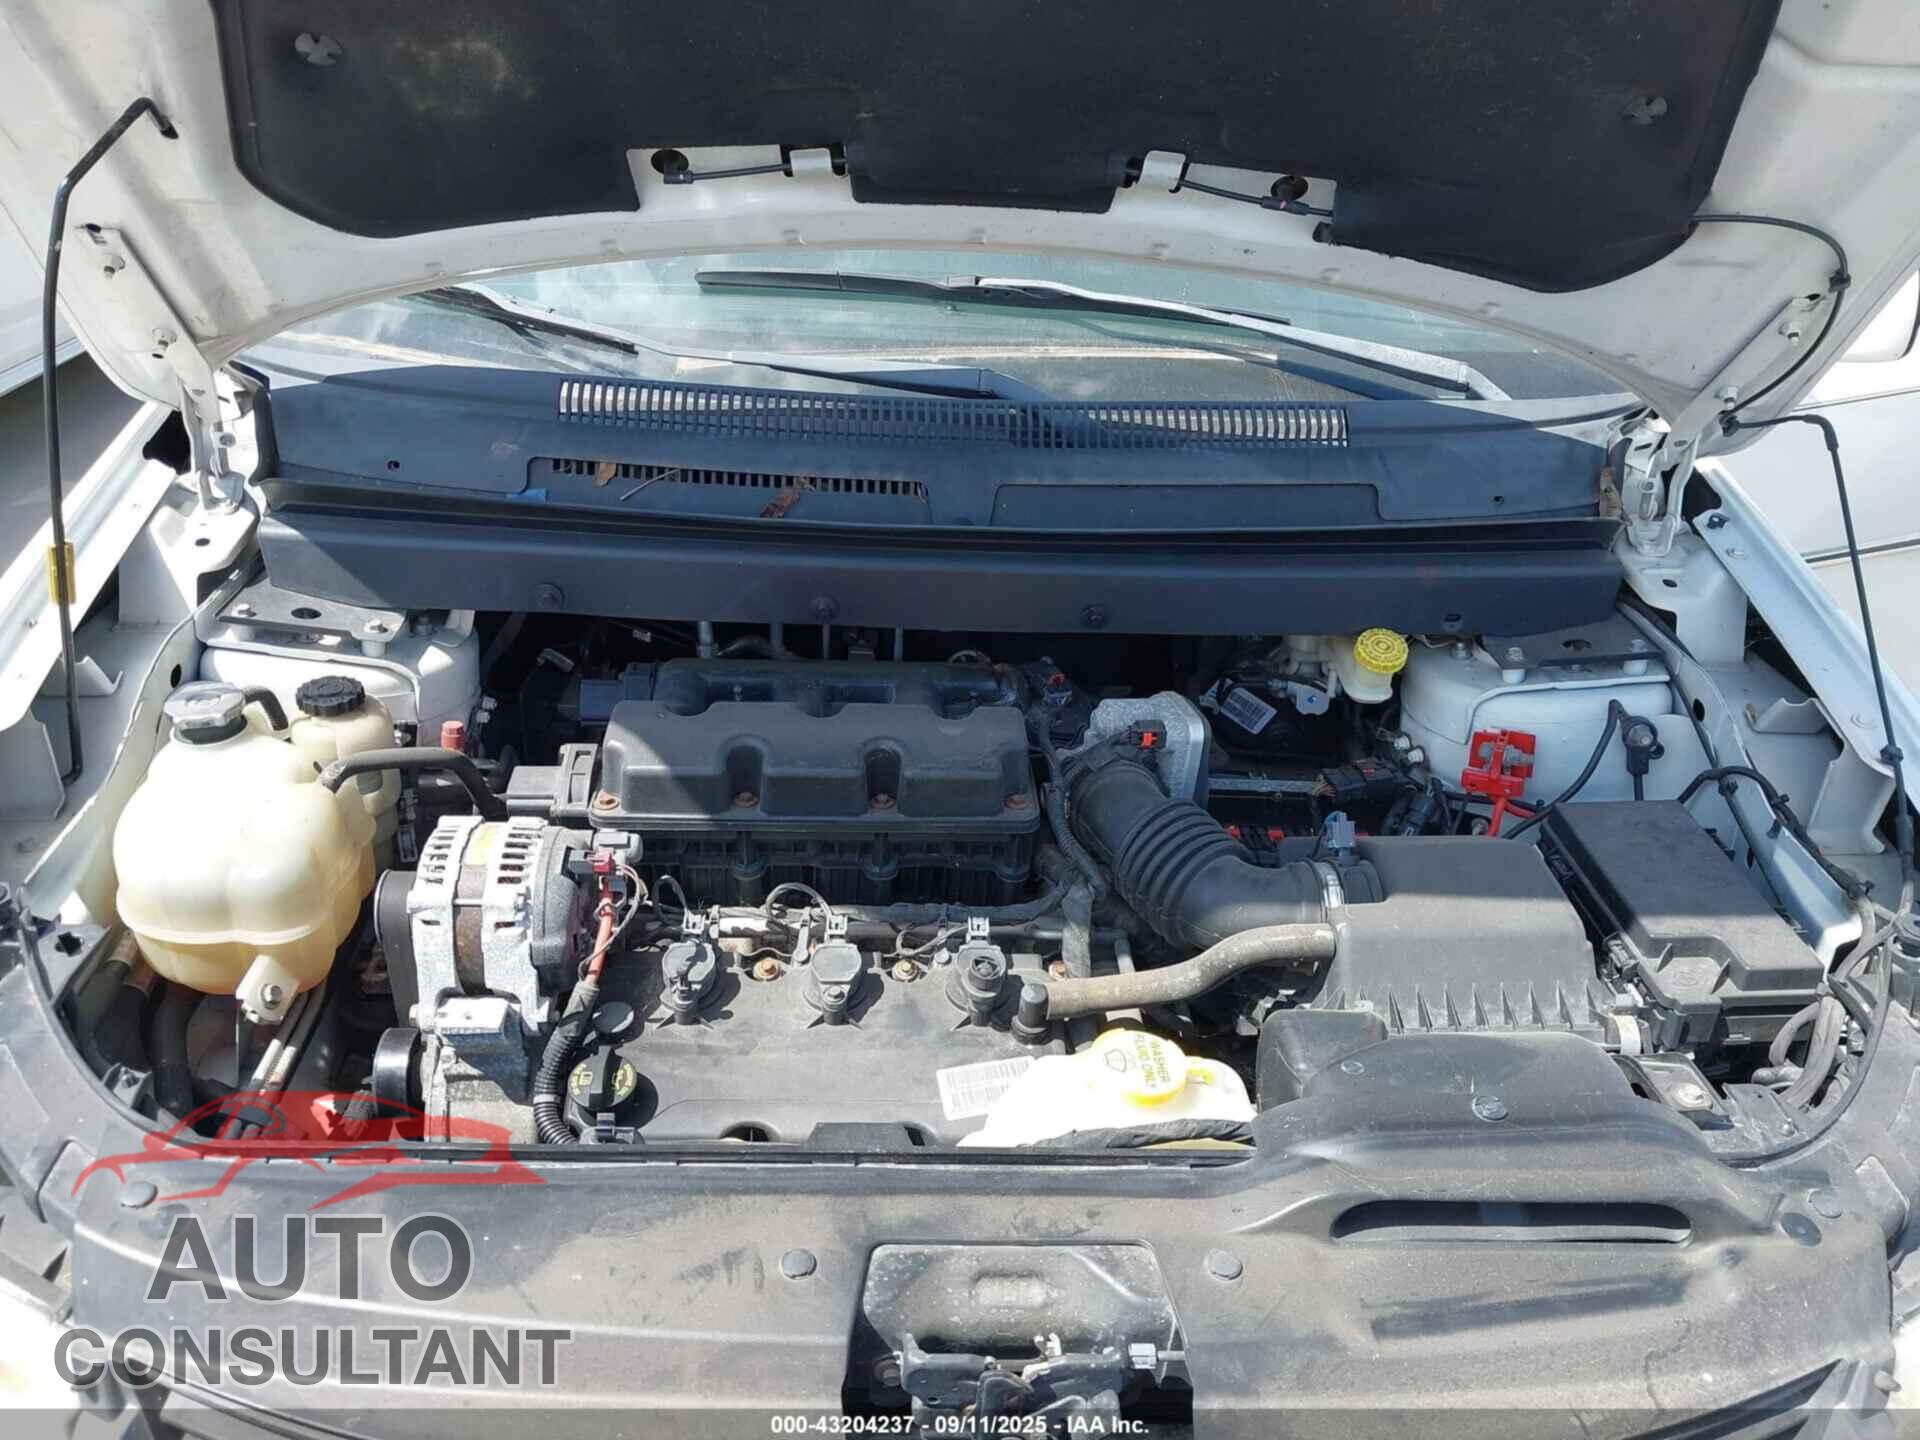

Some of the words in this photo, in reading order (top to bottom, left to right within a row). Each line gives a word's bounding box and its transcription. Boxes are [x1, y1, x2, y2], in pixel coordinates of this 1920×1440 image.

[1136, 1034, 1150, 1061] FLUID
[1151, 1039, 1171, 1082] WASHER
[1142, 1063, 1156, 1087] ONLY
